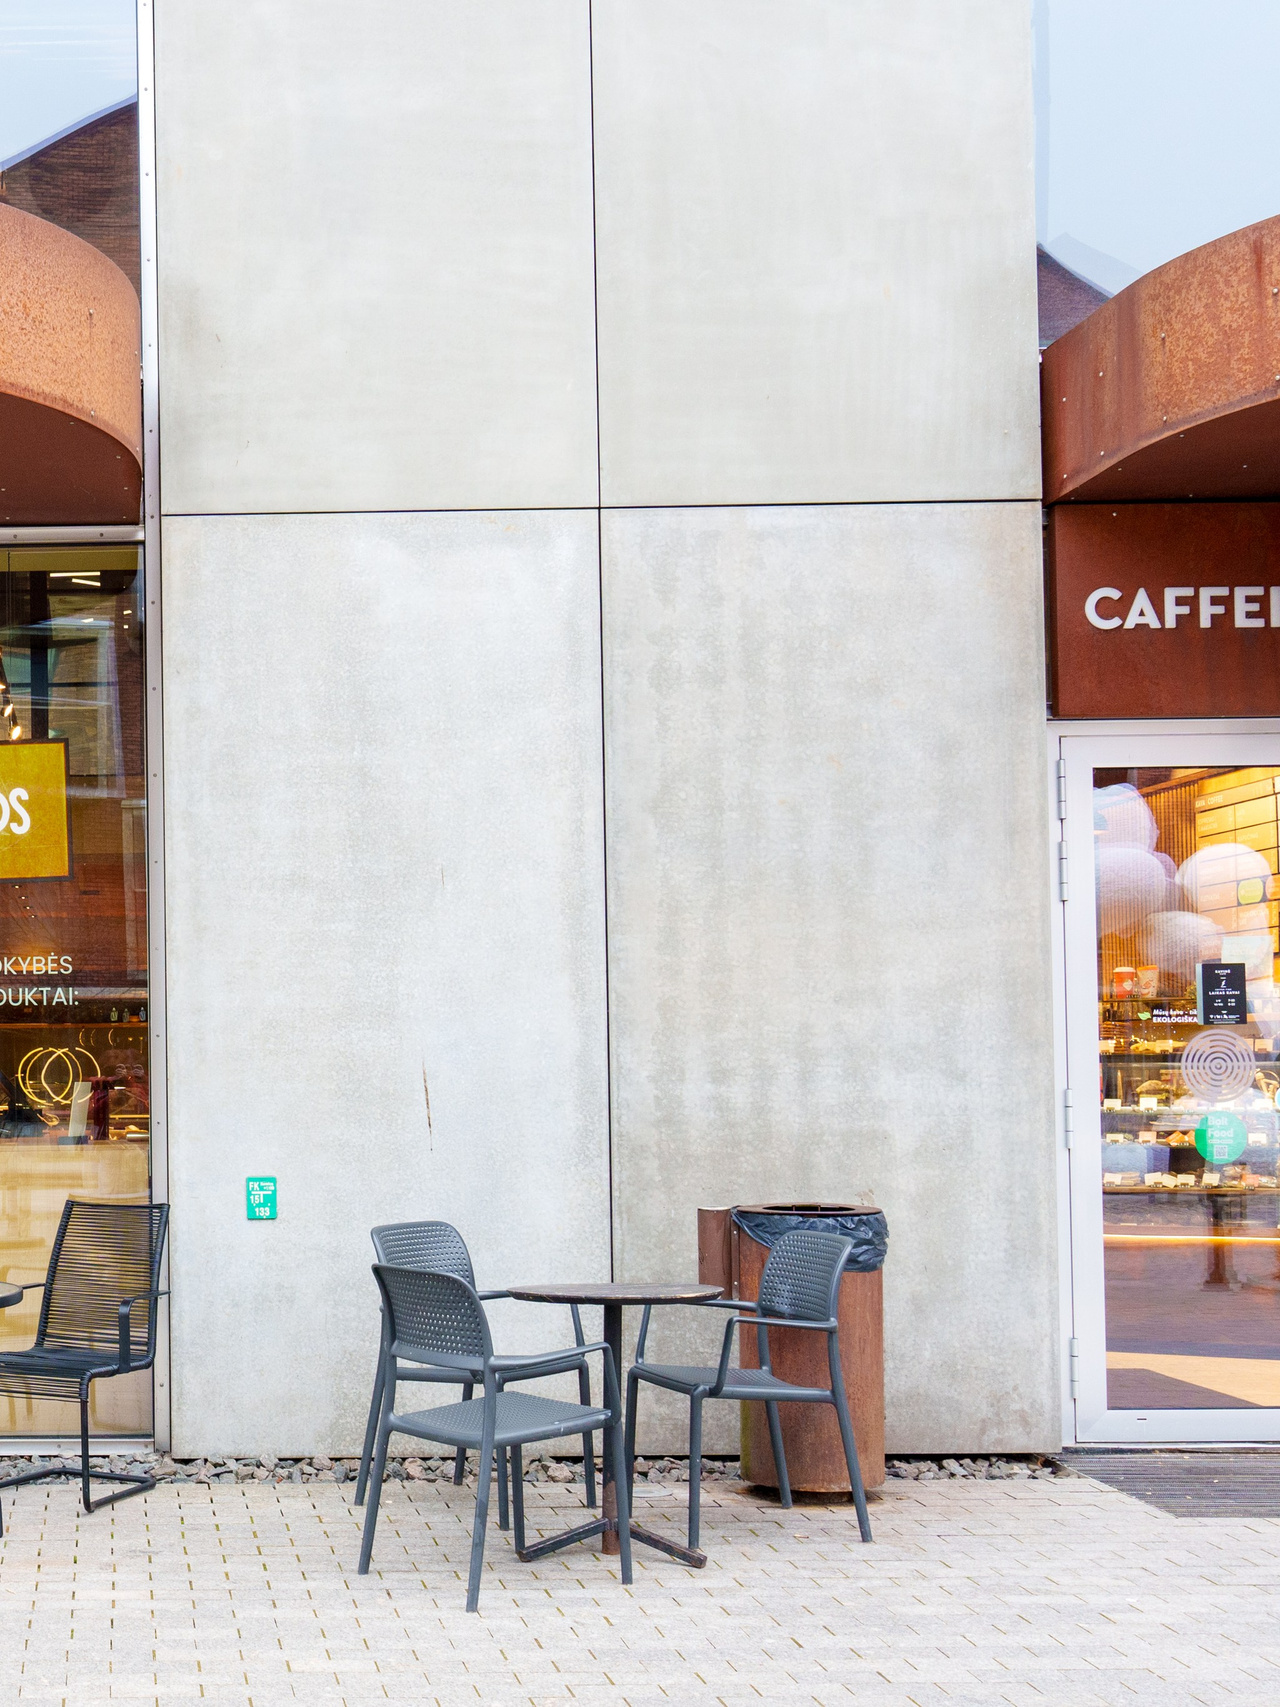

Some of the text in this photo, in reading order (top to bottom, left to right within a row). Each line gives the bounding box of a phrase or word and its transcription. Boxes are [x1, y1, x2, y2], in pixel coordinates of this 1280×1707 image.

[1207, 795, 1223, 805] COFFEE
[1208, 1128, 1233, 1138] Food
[249, 1181, 260, 1191] FK
